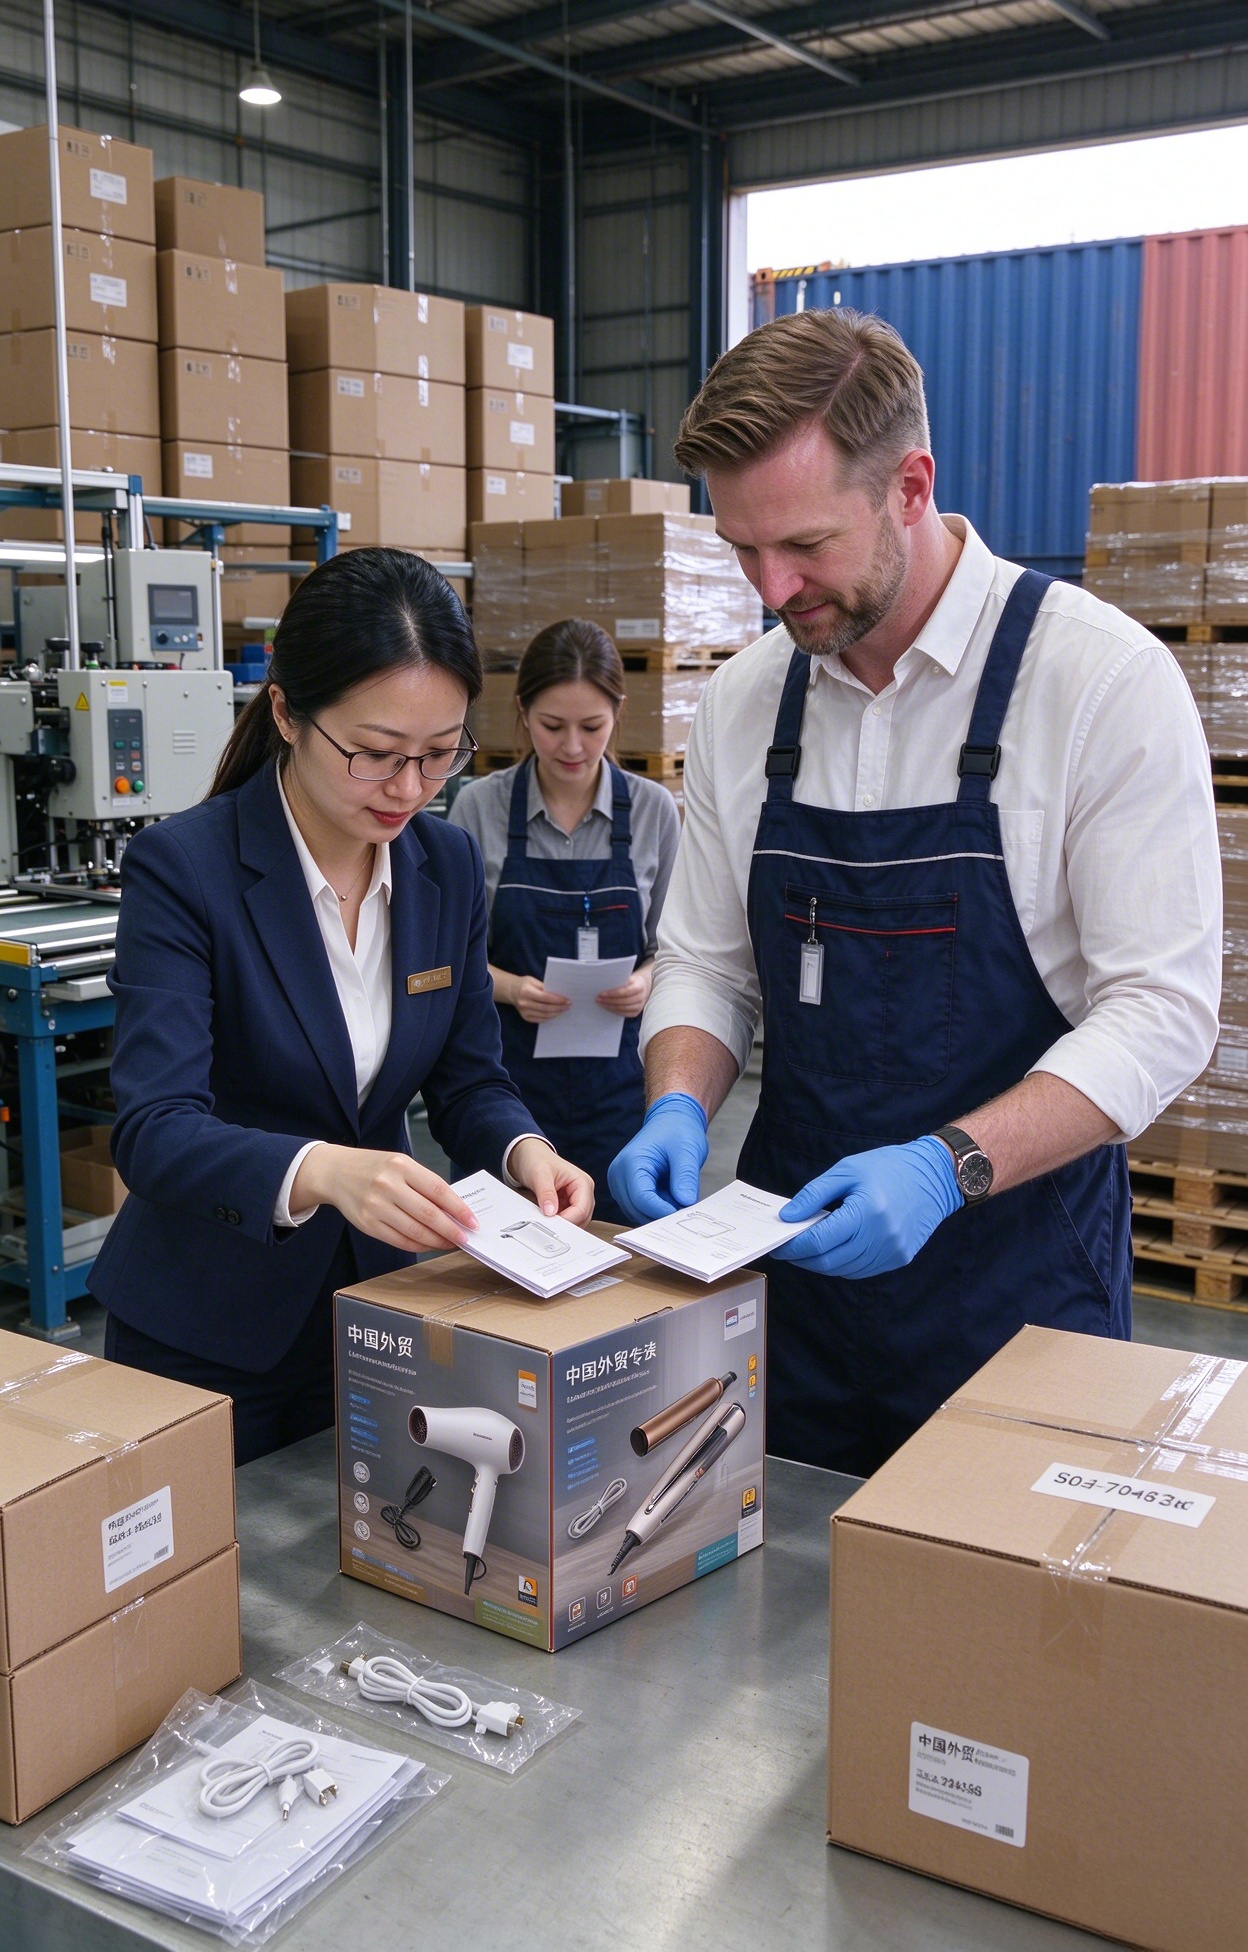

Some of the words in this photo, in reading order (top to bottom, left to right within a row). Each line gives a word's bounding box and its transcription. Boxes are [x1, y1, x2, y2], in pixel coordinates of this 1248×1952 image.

[348, 1324, 413, 1358] 中国外贸
[919, 1734, 975, 1763] 中国外贸
